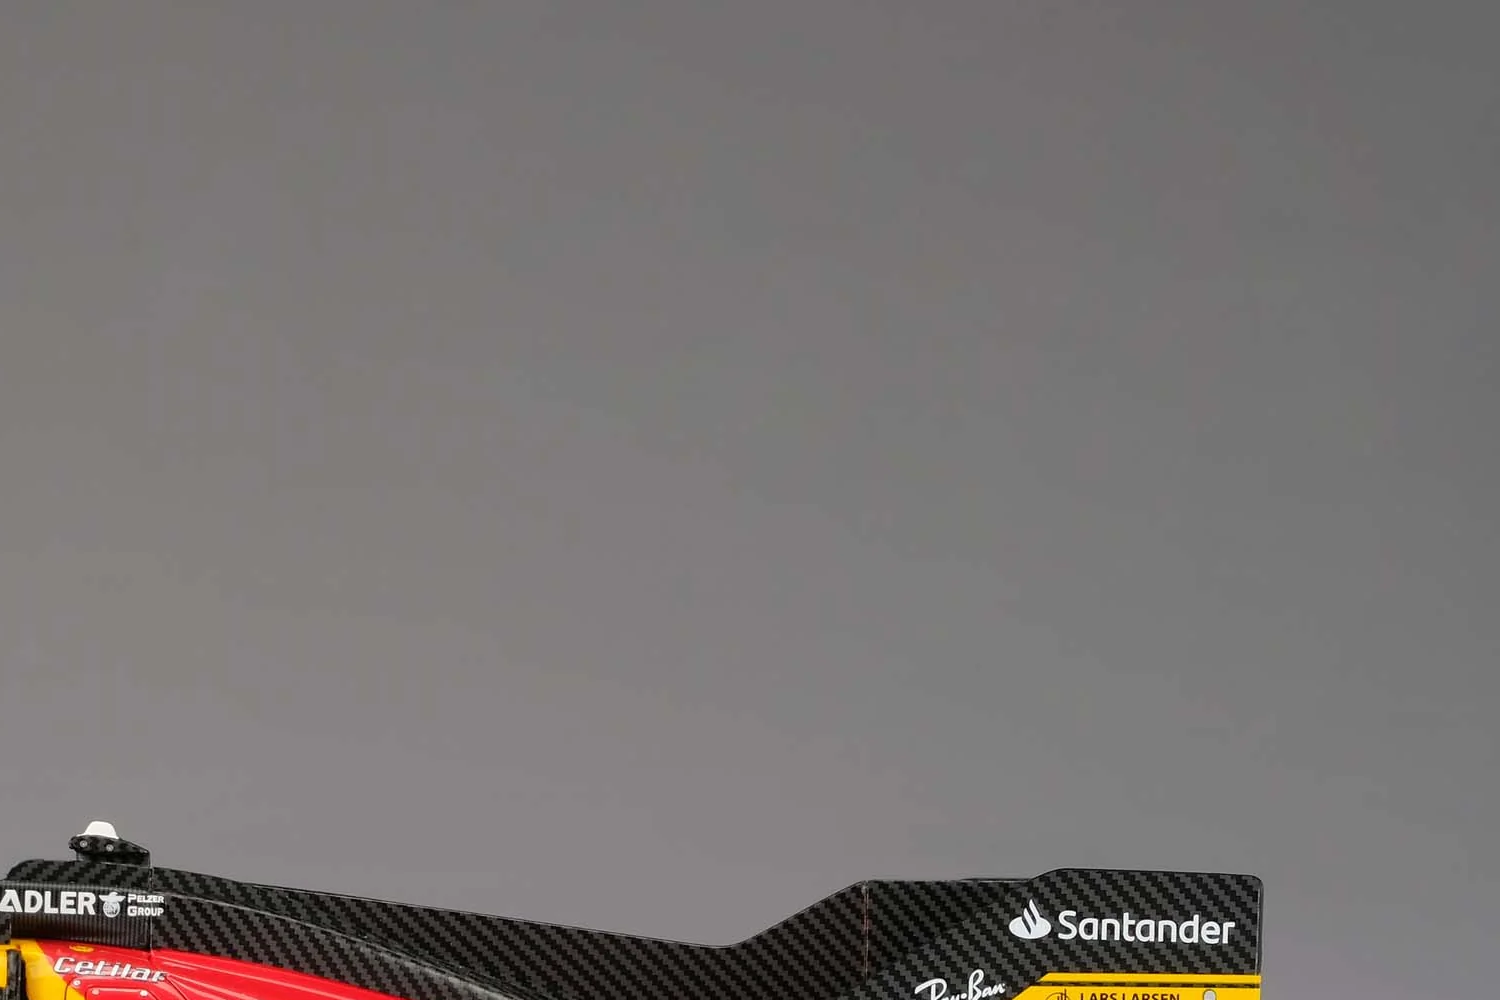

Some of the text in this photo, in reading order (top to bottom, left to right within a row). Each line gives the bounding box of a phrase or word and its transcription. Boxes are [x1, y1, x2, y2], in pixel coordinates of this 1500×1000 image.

[127, 893, 164, 904] PELZER
[127, 904, 164, 917] GROUP
[1057, 910, 1236, 945] Santander
[53, 956, 167, 982] Cetilar
